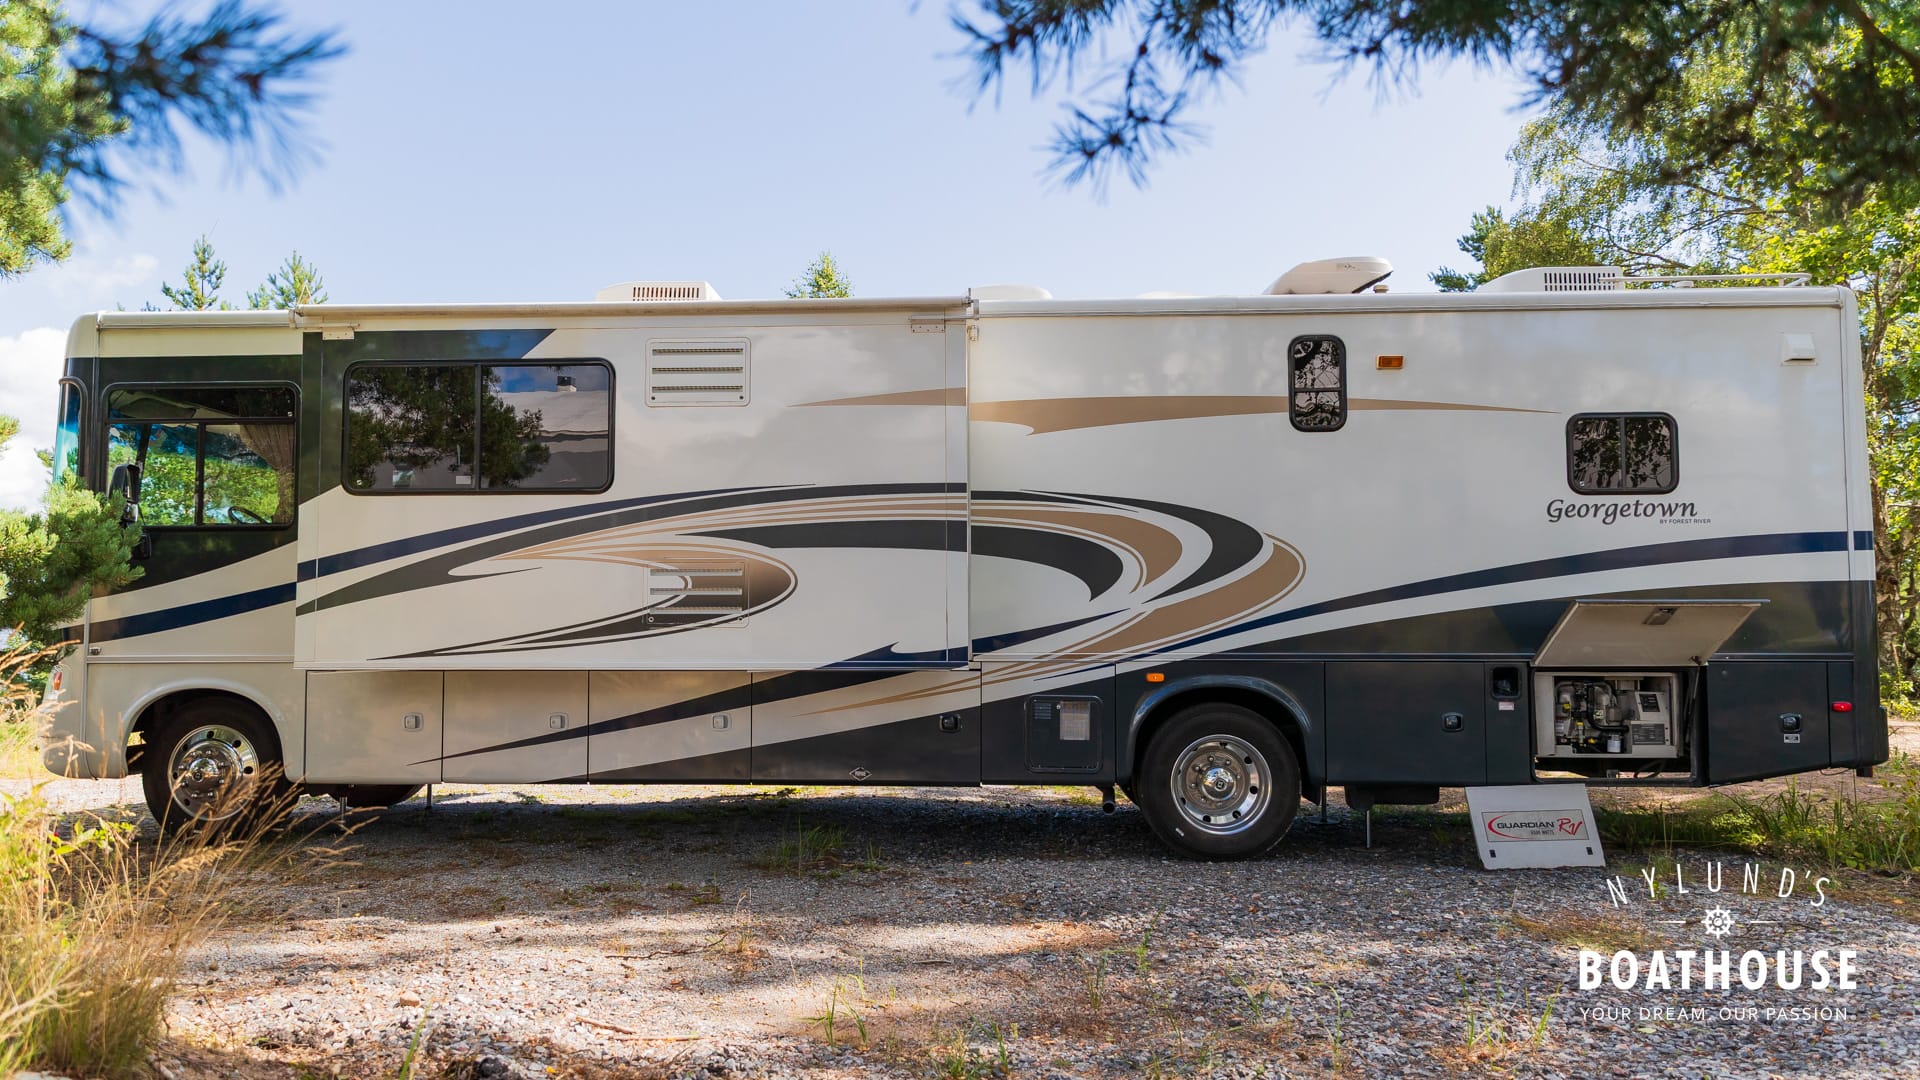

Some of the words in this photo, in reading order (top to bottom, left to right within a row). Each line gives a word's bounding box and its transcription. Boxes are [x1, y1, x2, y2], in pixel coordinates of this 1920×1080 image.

[1546, 499, 1698, 525] Georgetown
[1497, 821, 1554, 829] GUARDIAN
[1557, 817, 1583, 836] RV
